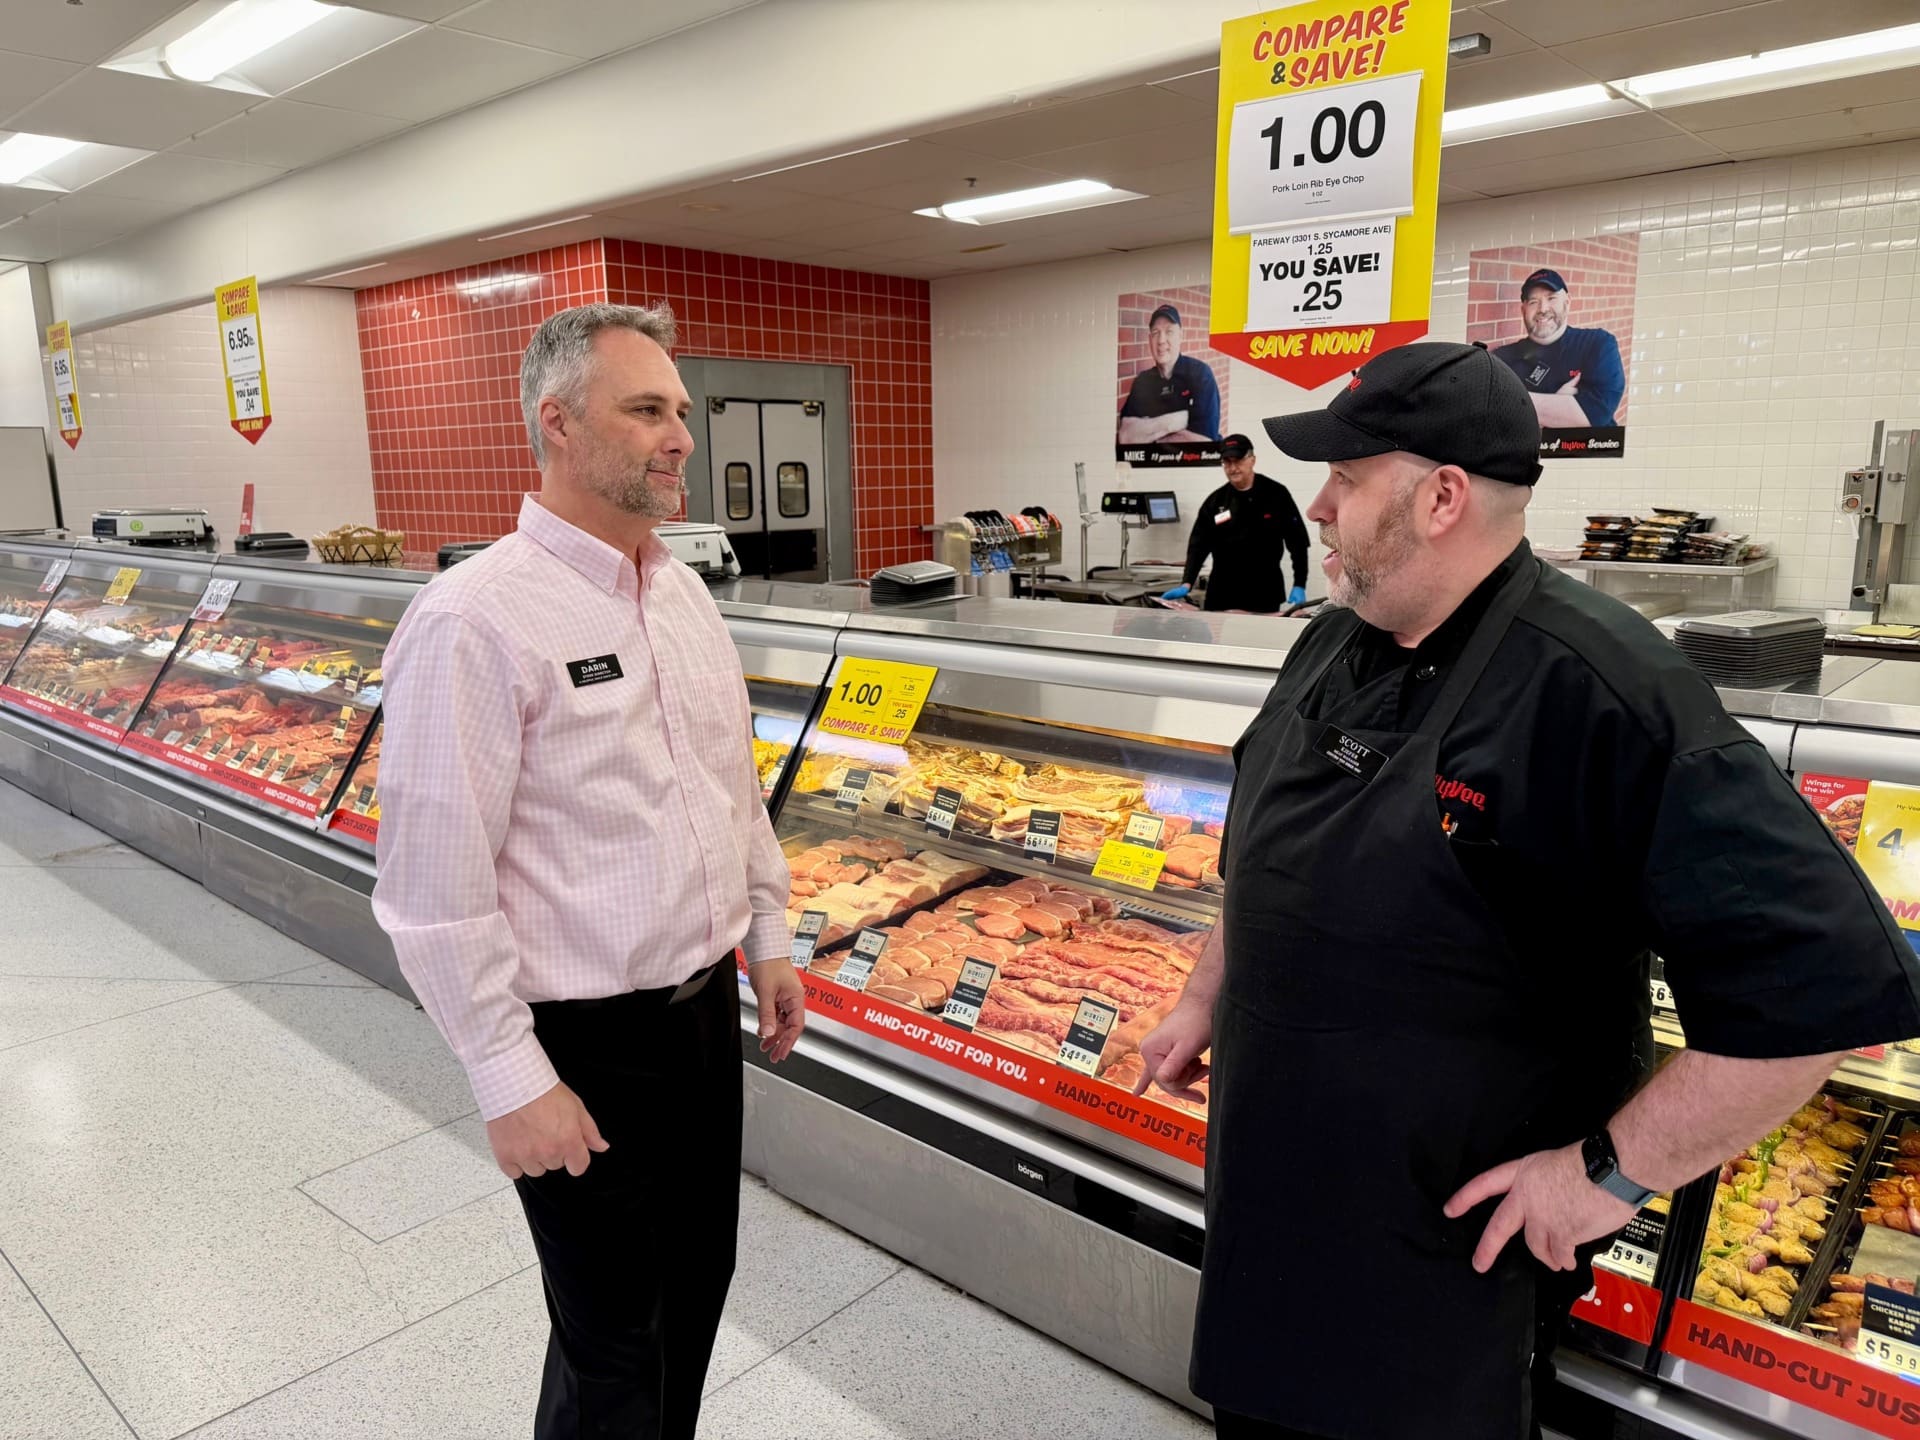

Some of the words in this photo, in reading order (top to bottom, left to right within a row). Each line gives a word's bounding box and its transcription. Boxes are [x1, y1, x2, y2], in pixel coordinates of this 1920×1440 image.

[1253, 0, 1410, 61] COMPARE
[1270, 61, 1286, 85] &
[1288, 40, 1386, 88] SAVE!
[1260, 99, 1386, 171] 1.00
[1272, 183, 1290, 194] Pork
[1292, 181, 1309, 191] Loin
[1310, 179, 1324, 189] Rib
[1326, 178, 1341, 188] Eye
[1342, 175, 1365, 185] Chop
[1253, 237, 1291, 247] FAREWAY
[1292, 234, 1311, 244] (3301
[1313, 233, 1321, 241] S.
[1323, 227, 1370, 240] SYCAMORE
[1372, 225, 1392, 234] AVE)
[1307, 243, 1333, 255] 1.25
[1260, 260, 1305, 281] YOU
[1313, 252, 1380, 277] SAVE!
[1293, 280, 1343, 312] .25
[1248, 333, 1307, 359] SAVE
[1310, 327, 1376, 356] NOW!
[1588, 438, 1620, 449] Service
[1124, 450, 1145, 461] MIKE
[581, 661, 609, 674] DARIN
[841, 681, 882, 706] 1.00
[822, 717, 870, 734] COMPARE
[870, 725, 878, 736] &
[1339, 735, 1371, 757] SCOTT
[1806, 779, 1832, 788] Wings
[836, 973, 860, 988] 3/5.00
[820, 990, 843, 1009] YOU.
[864, 1008, 931, 1042] HAND-CUT
[930, 1033, 964, 1055] JUST
[964, 1046, 994, 1067] FOR
[995, 1056, 1028, 1082] YOU.
[1055, 1081, 1140, 1124] HAND-CUT
[1140, 1114, 1184, 1141] JUST
[1626, 1226, 1648, 1237] KABOB
[1640, 1223, 1664, 1236] BREAST
[1870, 1304, 1904, 1320] CHICKEN
[1888, 1317, 1916, 1330] KABOB
[1688, 1323, 1852, 1398] HAND-CUT
